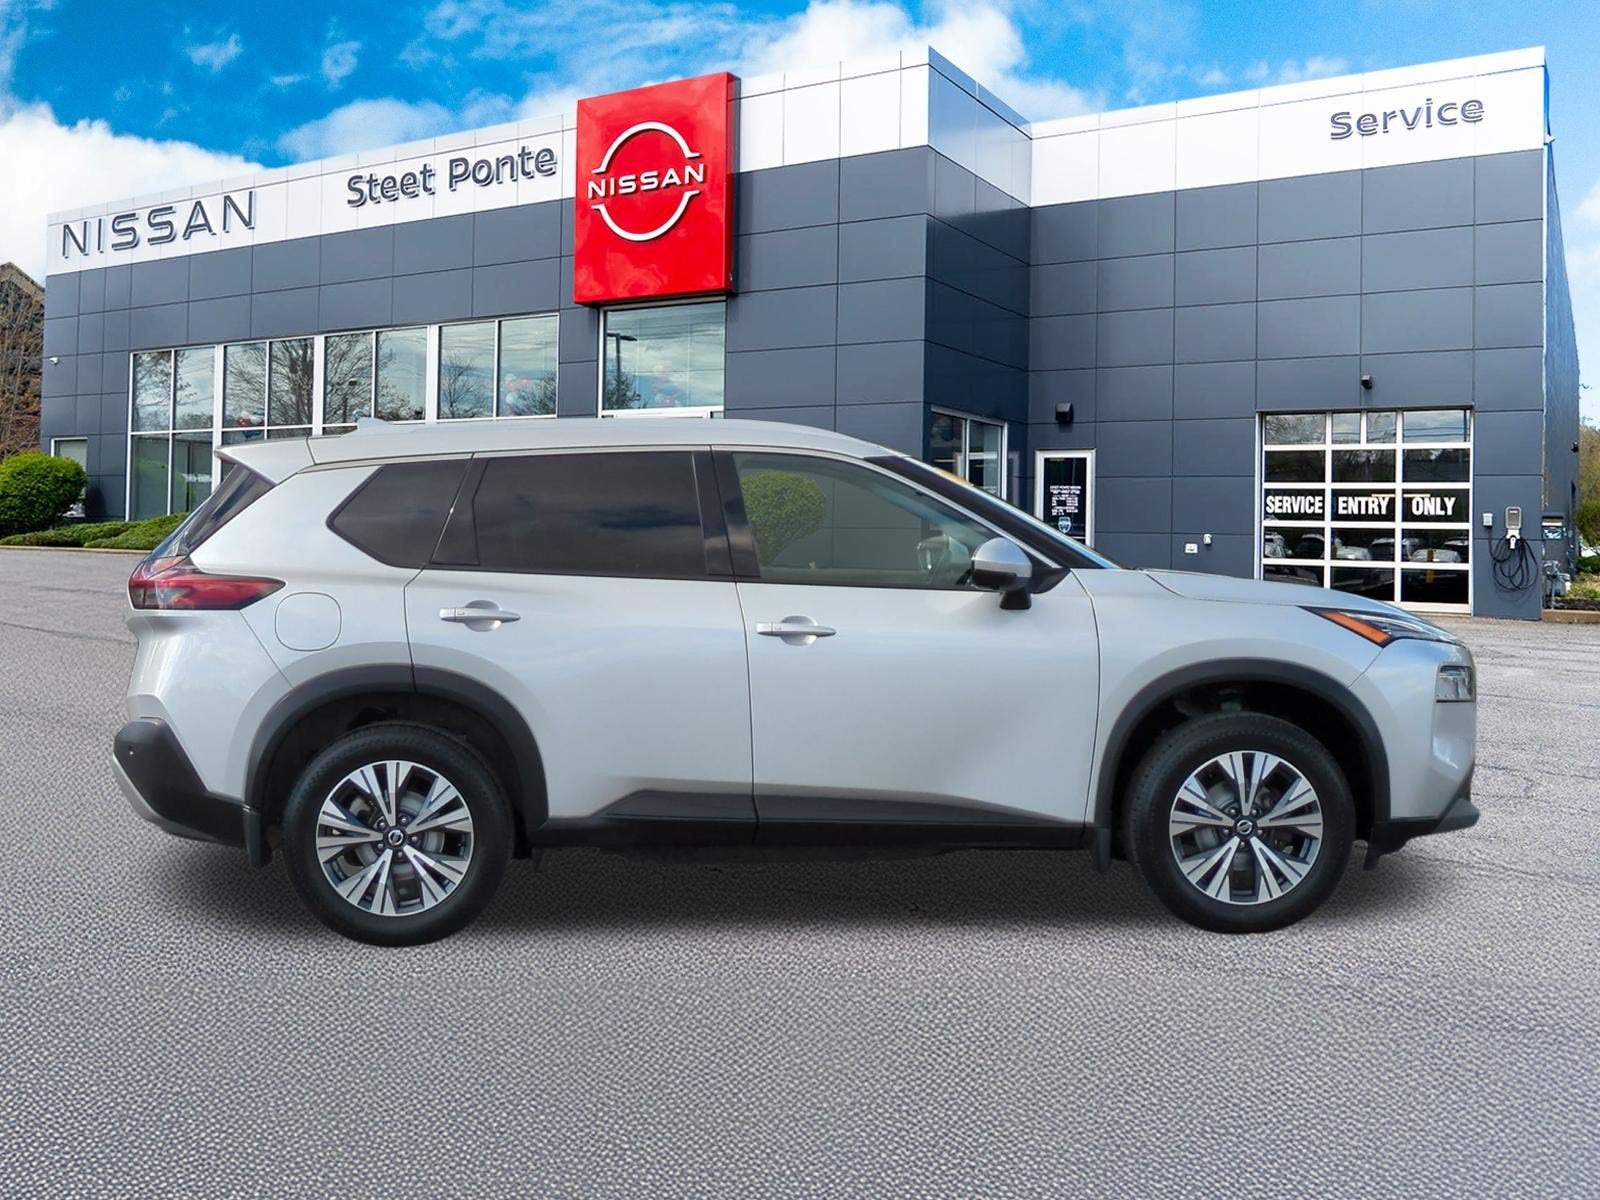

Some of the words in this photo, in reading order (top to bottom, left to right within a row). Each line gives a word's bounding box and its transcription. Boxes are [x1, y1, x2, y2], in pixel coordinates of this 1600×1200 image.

[1330, 98, 1484, 140] Service
[347, 163, 436, 207] Steet
[449, 146, 557, 191] Ponte
[587, 163, 705, 199] NISSAN
[62, 191, 255, 259] NISSAN
[1265, 495, 1323, 514] SERVICE
[1338, 496, 1390, 515] ENTRY
[1411, 496, 1456, 515] ONLY
